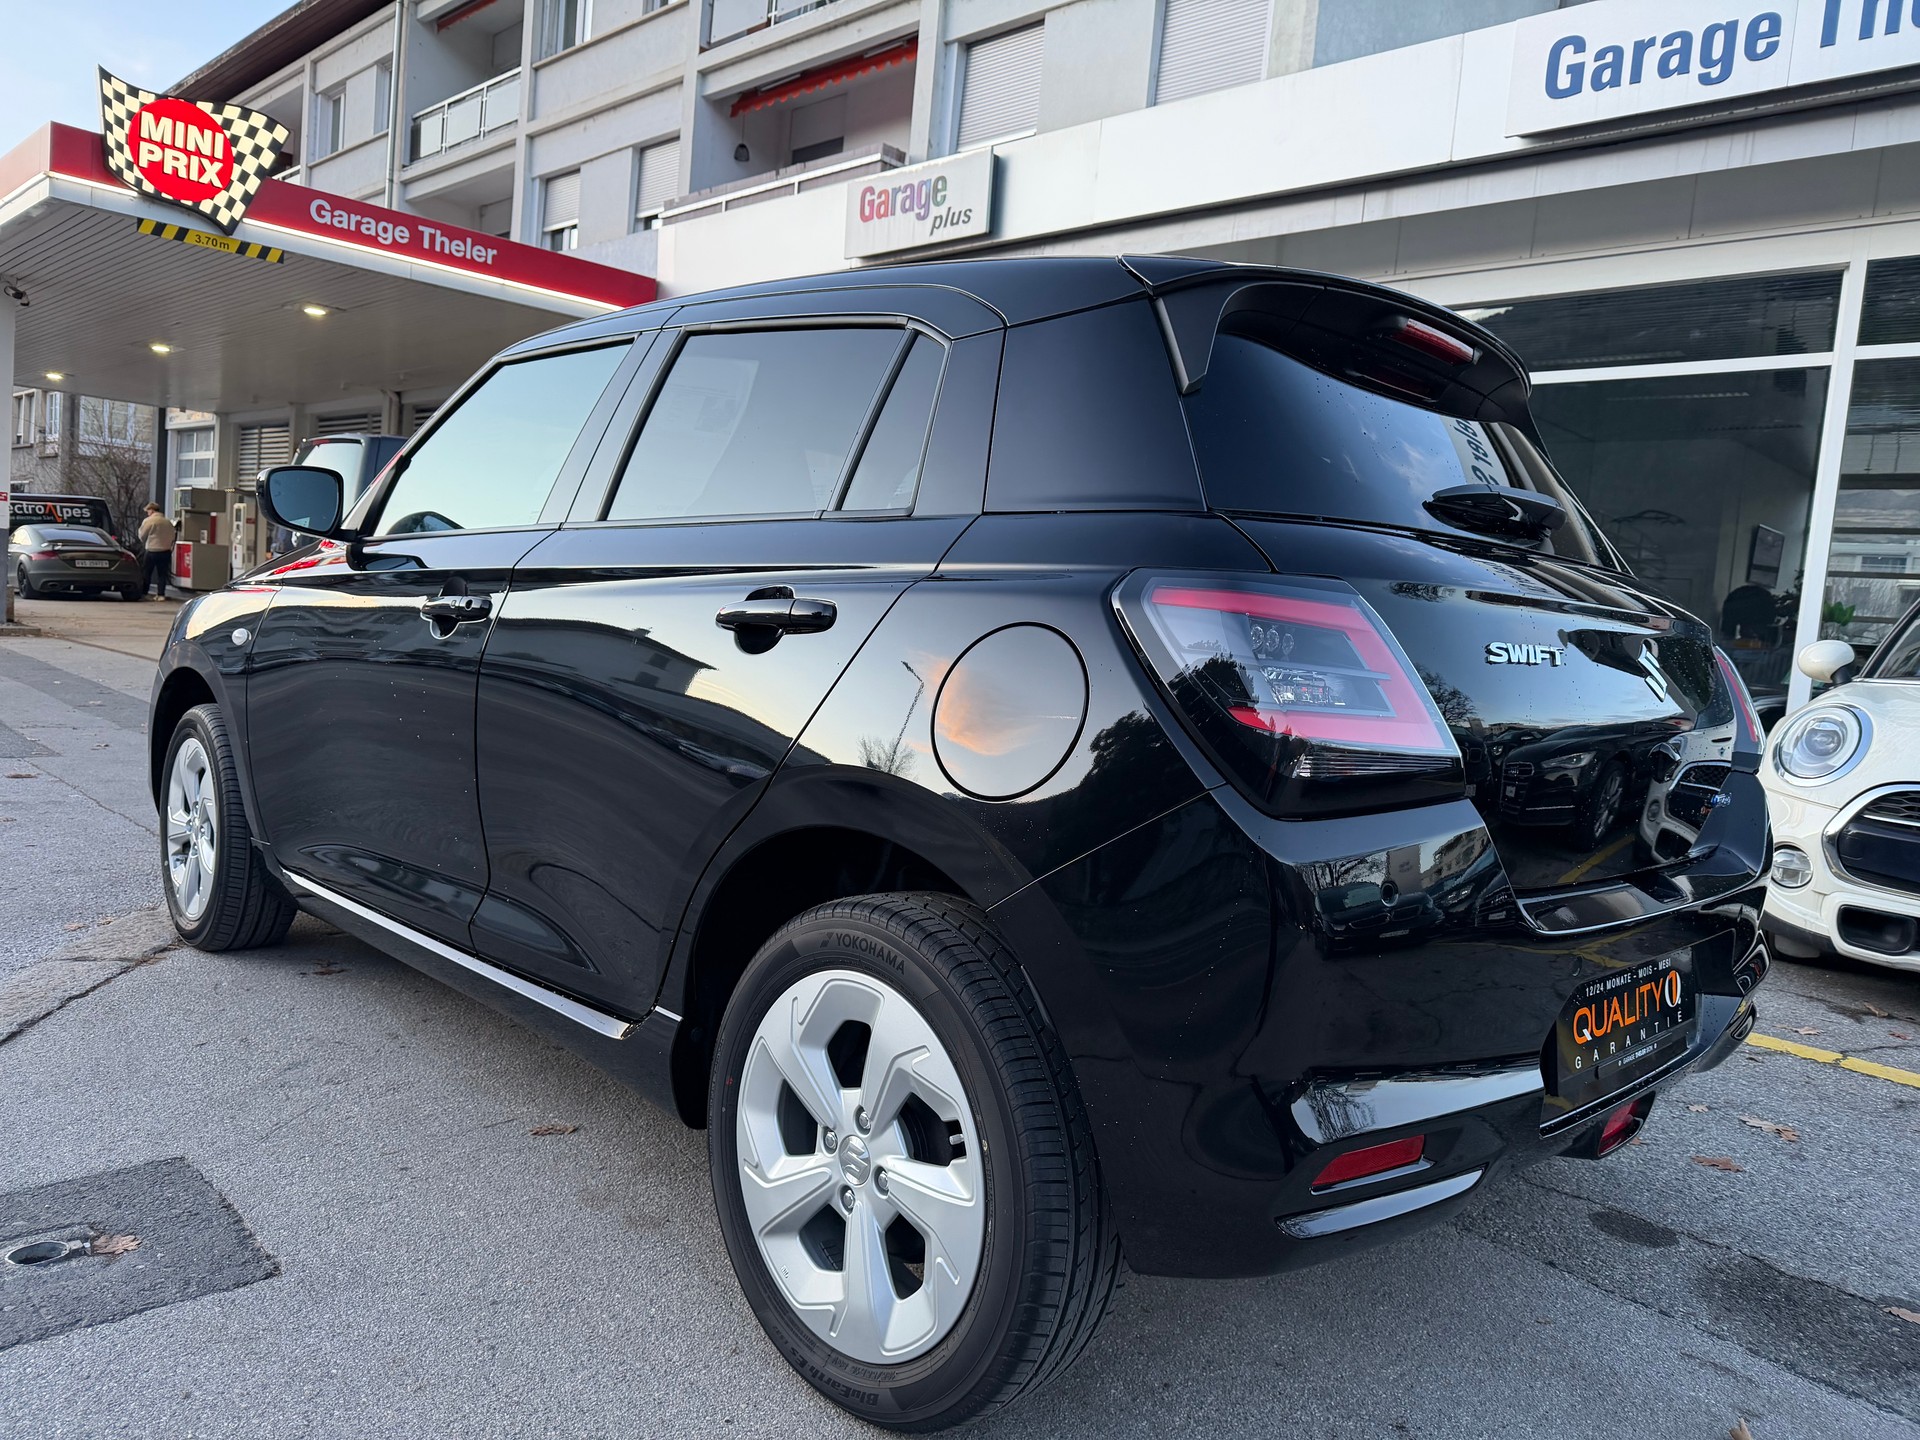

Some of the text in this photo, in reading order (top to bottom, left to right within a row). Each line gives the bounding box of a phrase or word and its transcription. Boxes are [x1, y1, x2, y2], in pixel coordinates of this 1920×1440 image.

[1545, 11, 1782, 100] Garage
[139, 110, 225, 160] MINI
[138, 141, 224, 189] PRIX
[859, 175, 948, 223] Garage
[929, 206, 974, 237] plus
[309, 198, 498, 266] Garage Theler
[1484, 641, 1565, 667] SWIFT
[835, 932, 906, 976] YOKOHAMA
[1585, 982, 1604, 997] 12/24
[1606, 972, 1632, 991] MONATE
[1638, 965, 1653, 979] MOIS
[1658, 957, 1671, 971] MESI
[1575, 1010, 1683, 1070] GARANTIE
